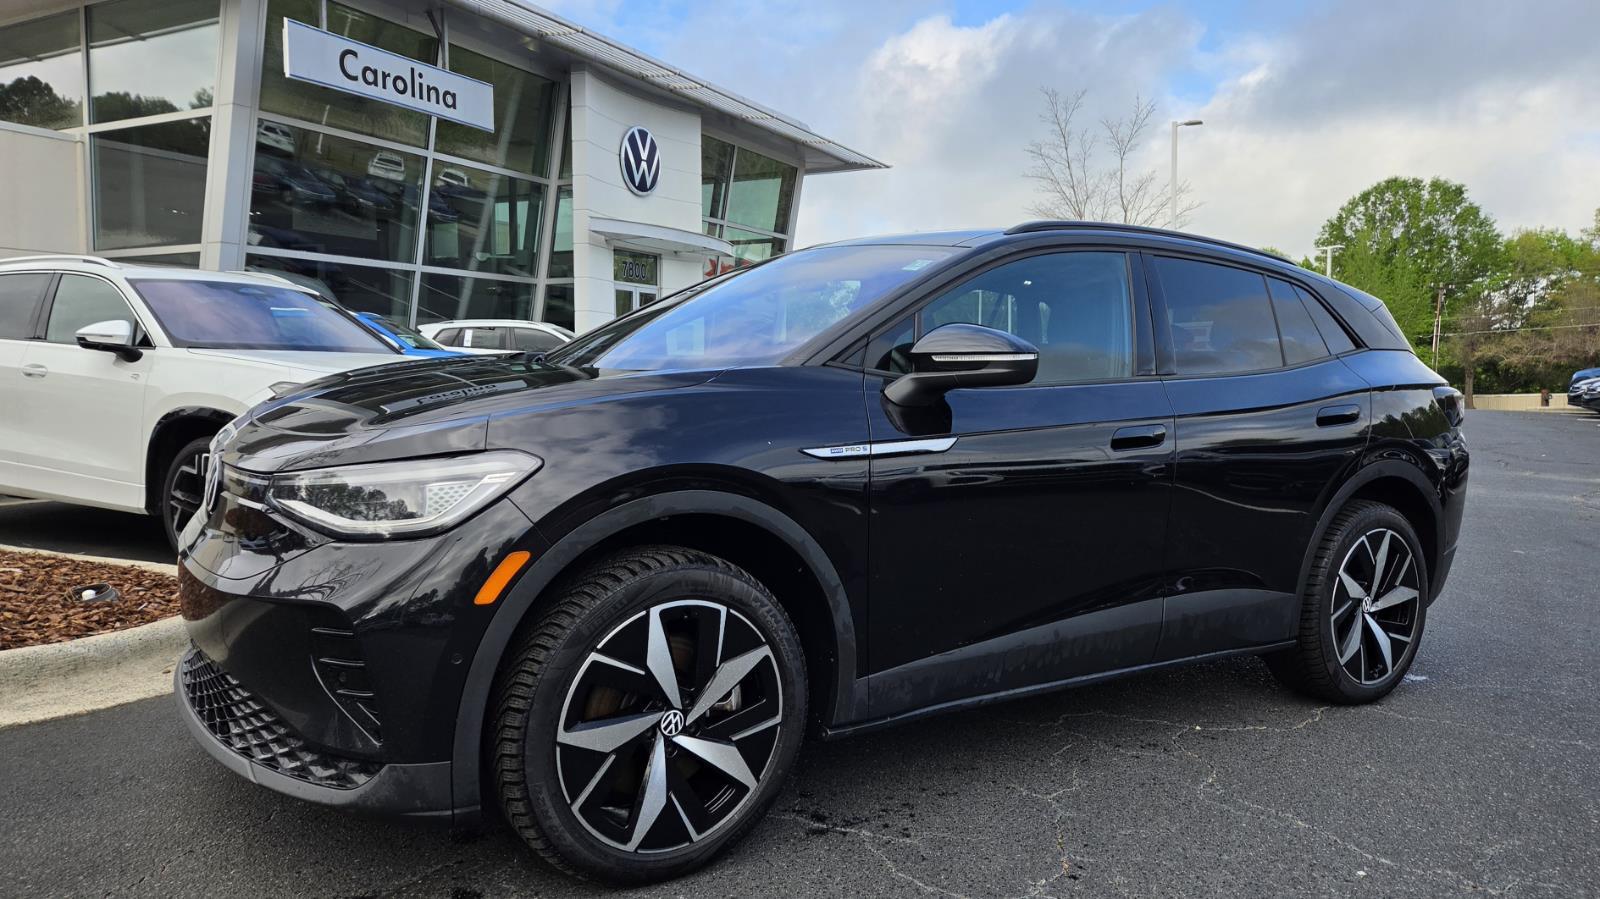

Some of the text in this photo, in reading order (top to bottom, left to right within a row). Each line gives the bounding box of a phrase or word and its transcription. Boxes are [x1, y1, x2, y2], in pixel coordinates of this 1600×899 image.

[339, 49, 457, 110] Carolina
[621, 126, 660, 195] VW
[622, 261, 647, 279] 7800
